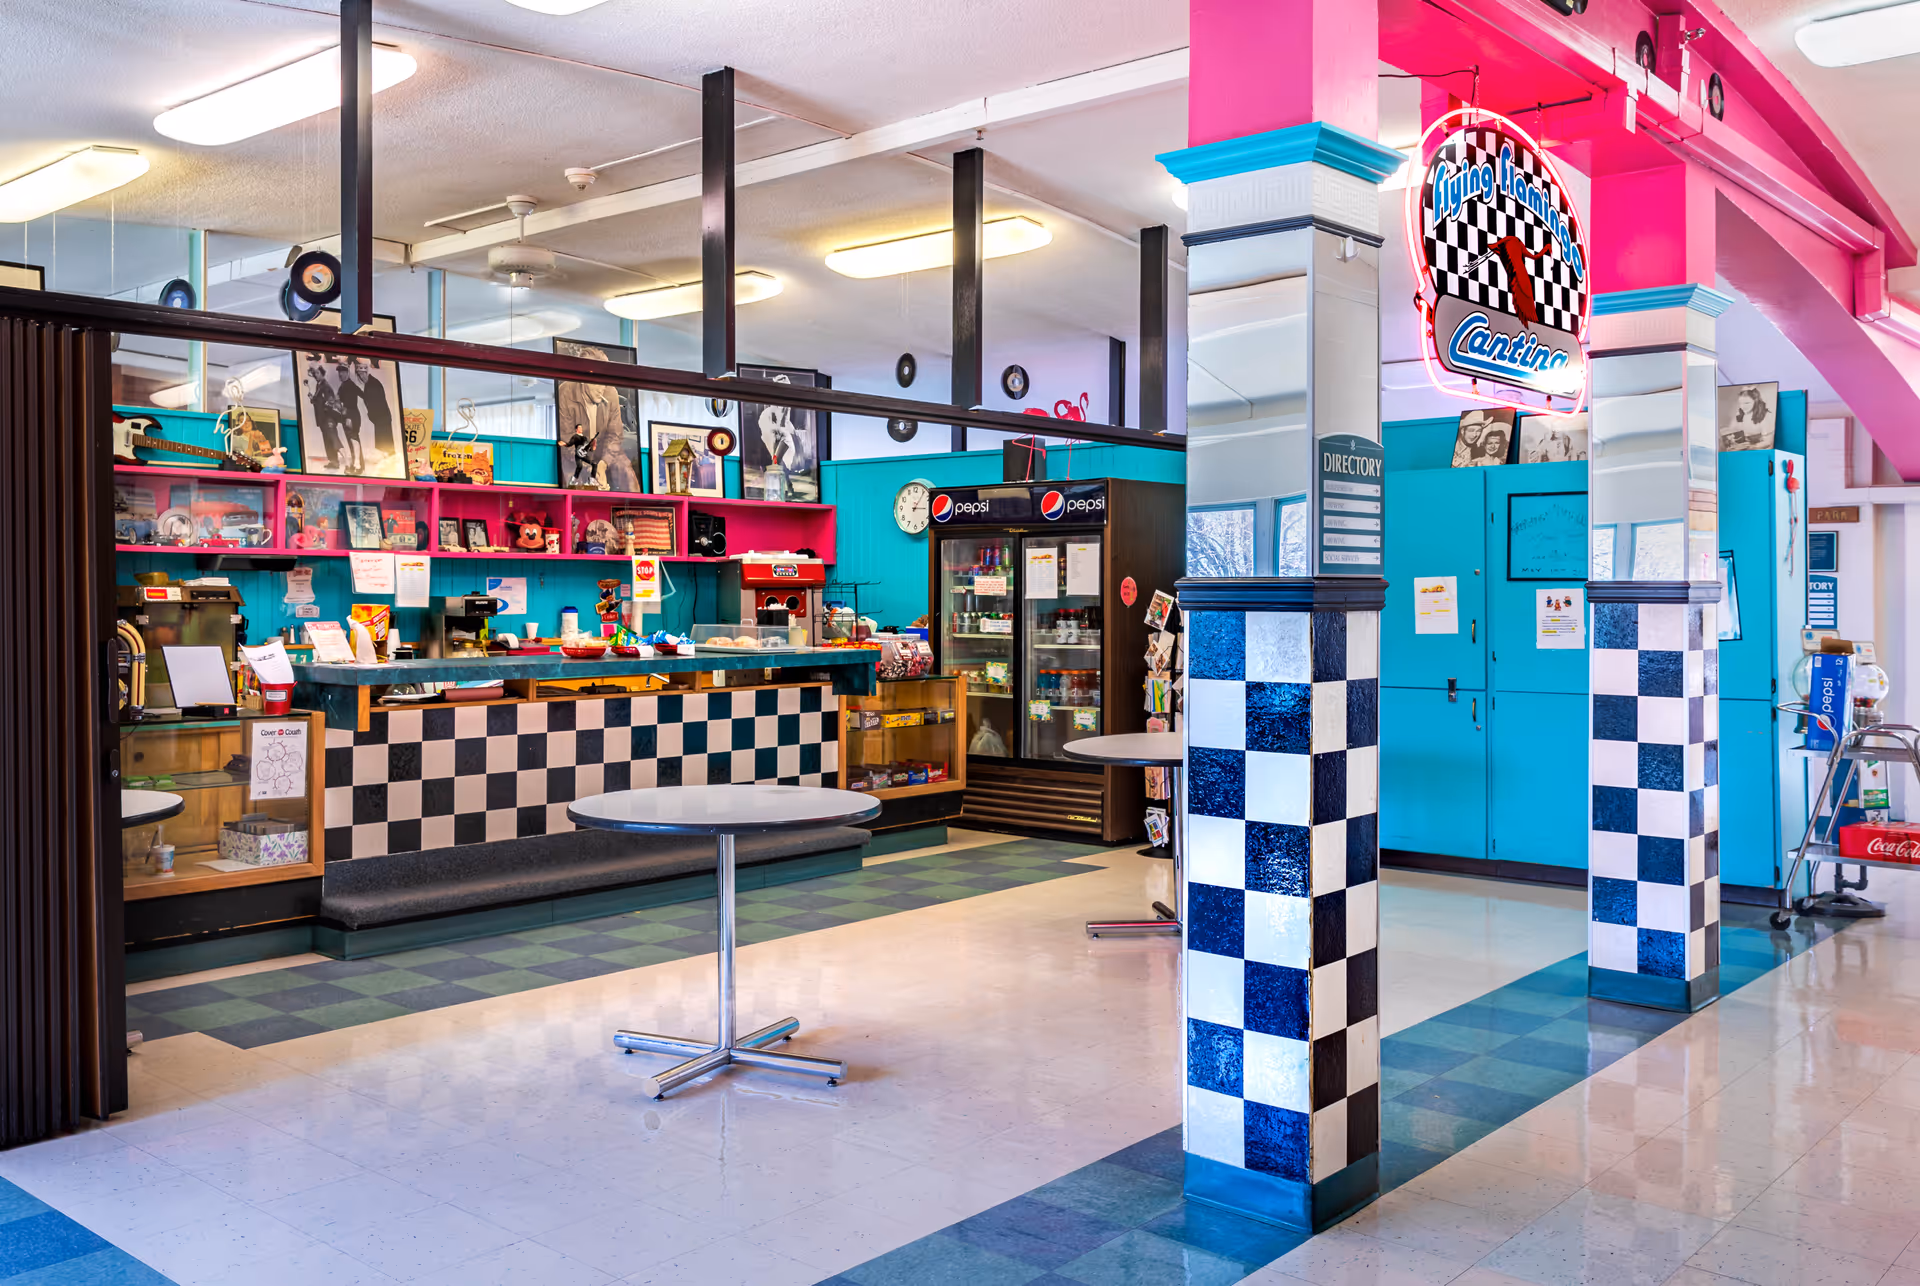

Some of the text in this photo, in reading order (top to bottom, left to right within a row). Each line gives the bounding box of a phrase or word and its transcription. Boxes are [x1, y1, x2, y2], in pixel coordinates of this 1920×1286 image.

[1449, 311, 1568, 374] Cantina
[1323, 452, 1382, 477] DIRECTORY
[955, 500, 989, 515] pepsi
[1067, 496, 1105, 513] pepsi
[1817, 511, 1848, 520] PARK
[1821, 678, 1835, 713] pepsi
